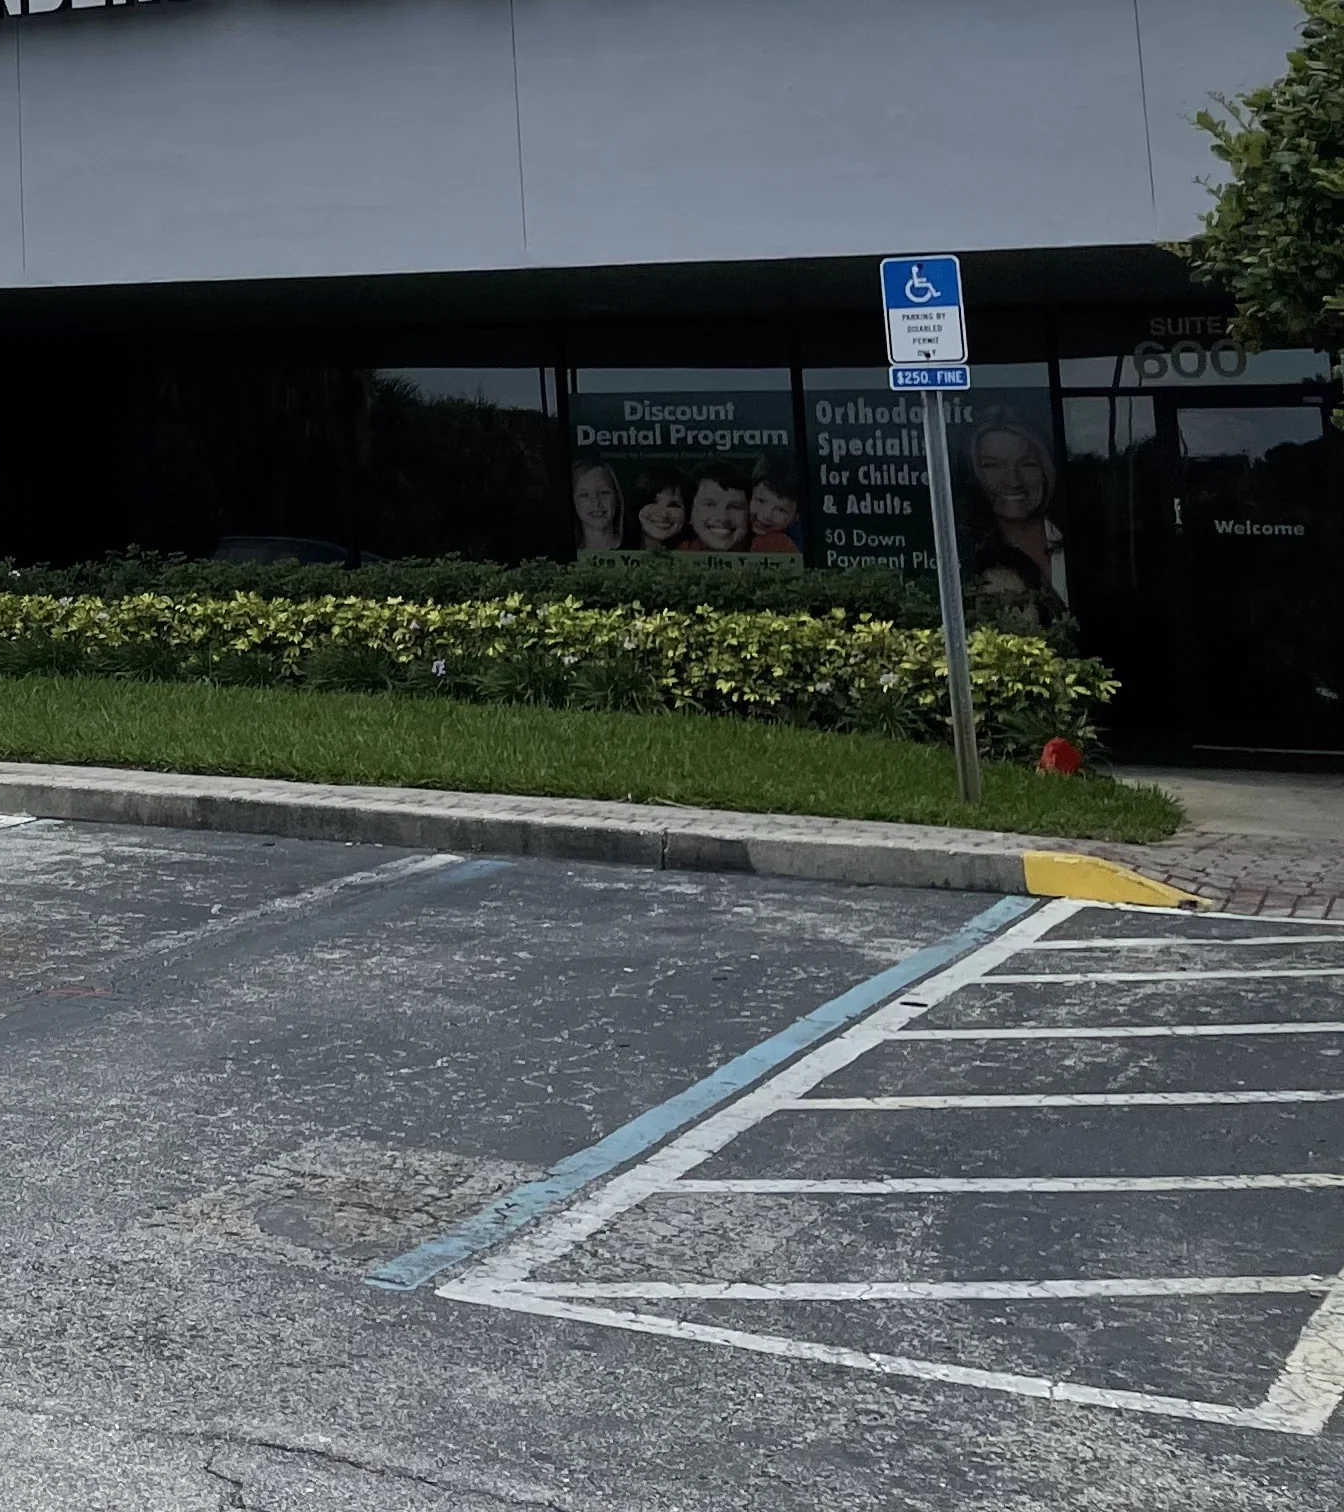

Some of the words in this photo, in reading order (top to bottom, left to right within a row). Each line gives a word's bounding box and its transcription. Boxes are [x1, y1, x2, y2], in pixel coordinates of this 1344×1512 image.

[902, 312, 933, 321] PARKING
[936, 312, 946, 320] BY
[1149, 316, 1224, 336] SUITE
[907, 325, 942, 333] DISABLED
[912, 336, 939, 345] PERMIT
[1132, 338, 1247, 378] 600
[937, 370, 964, 384] FINE
[623, 399, 736, 421] Discount
[815, 395, 974, 425] Orthodotic
[576, 423, 662, 447] Dental
[669, 423, 790, 451] Program
[820, 463, 850, 486] for
[858, 463, 930, 486] Childre
[822, 494, 838, 515] &
[846, 492, 912, 515] Adults
[1213, 518, 1306, 537] Welcome
[824, 528, 846, 546] $0
[852, 529, 906, 547] Down
[826, 550, 906, 569] Payment
